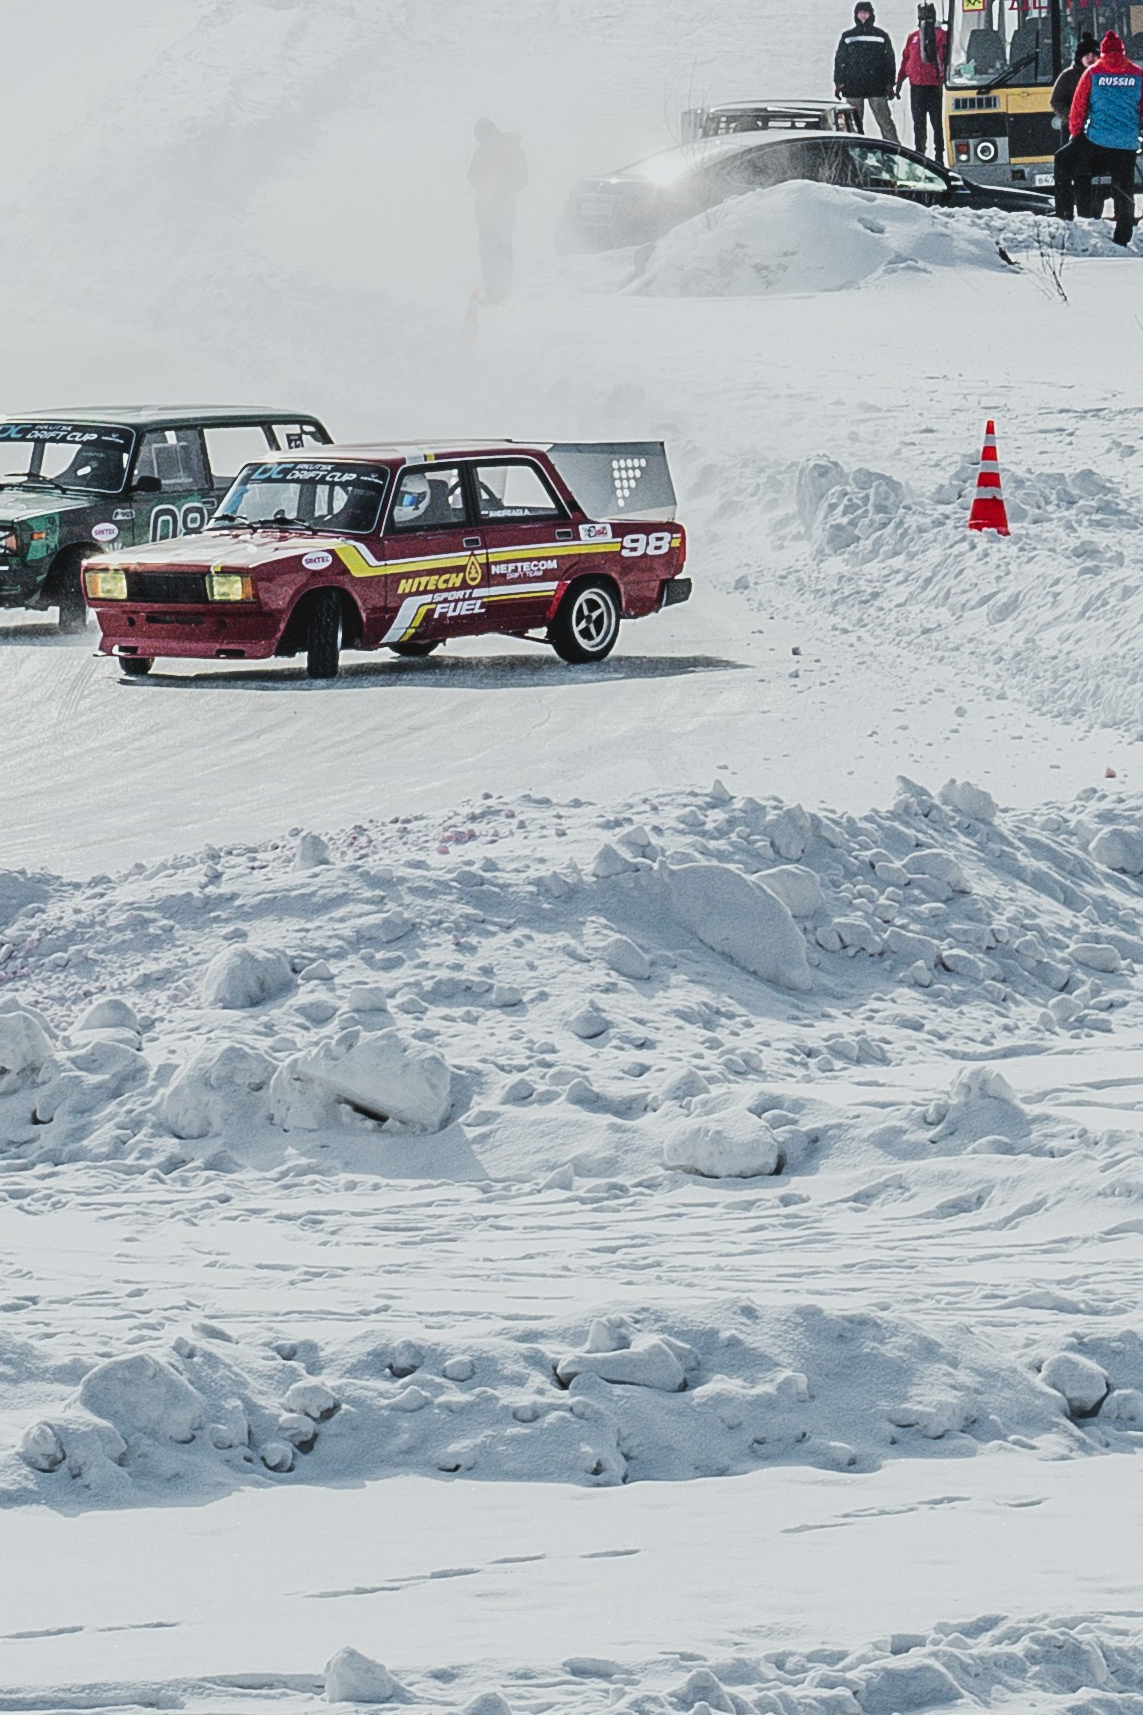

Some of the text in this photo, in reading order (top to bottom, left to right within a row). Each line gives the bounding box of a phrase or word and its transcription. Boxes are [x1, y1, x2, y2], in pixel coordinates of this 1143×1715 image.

[1098, 76, 1136, 87] RUSSIA
[26, 430, 68, 440] DRIFT
[65, 433, 99, 442] CUP
[285, 471, 328, 480] DRIFT
[325, 472, 358, 482] CUP
[621, 532, 671, 557] 98
[491, 559, 558, 575] NEFTECOM
[397, 572, 464, 594] HITECH
[432, 589, 473, 602] SPORT
[433, 600, 487, 618] FUEL
